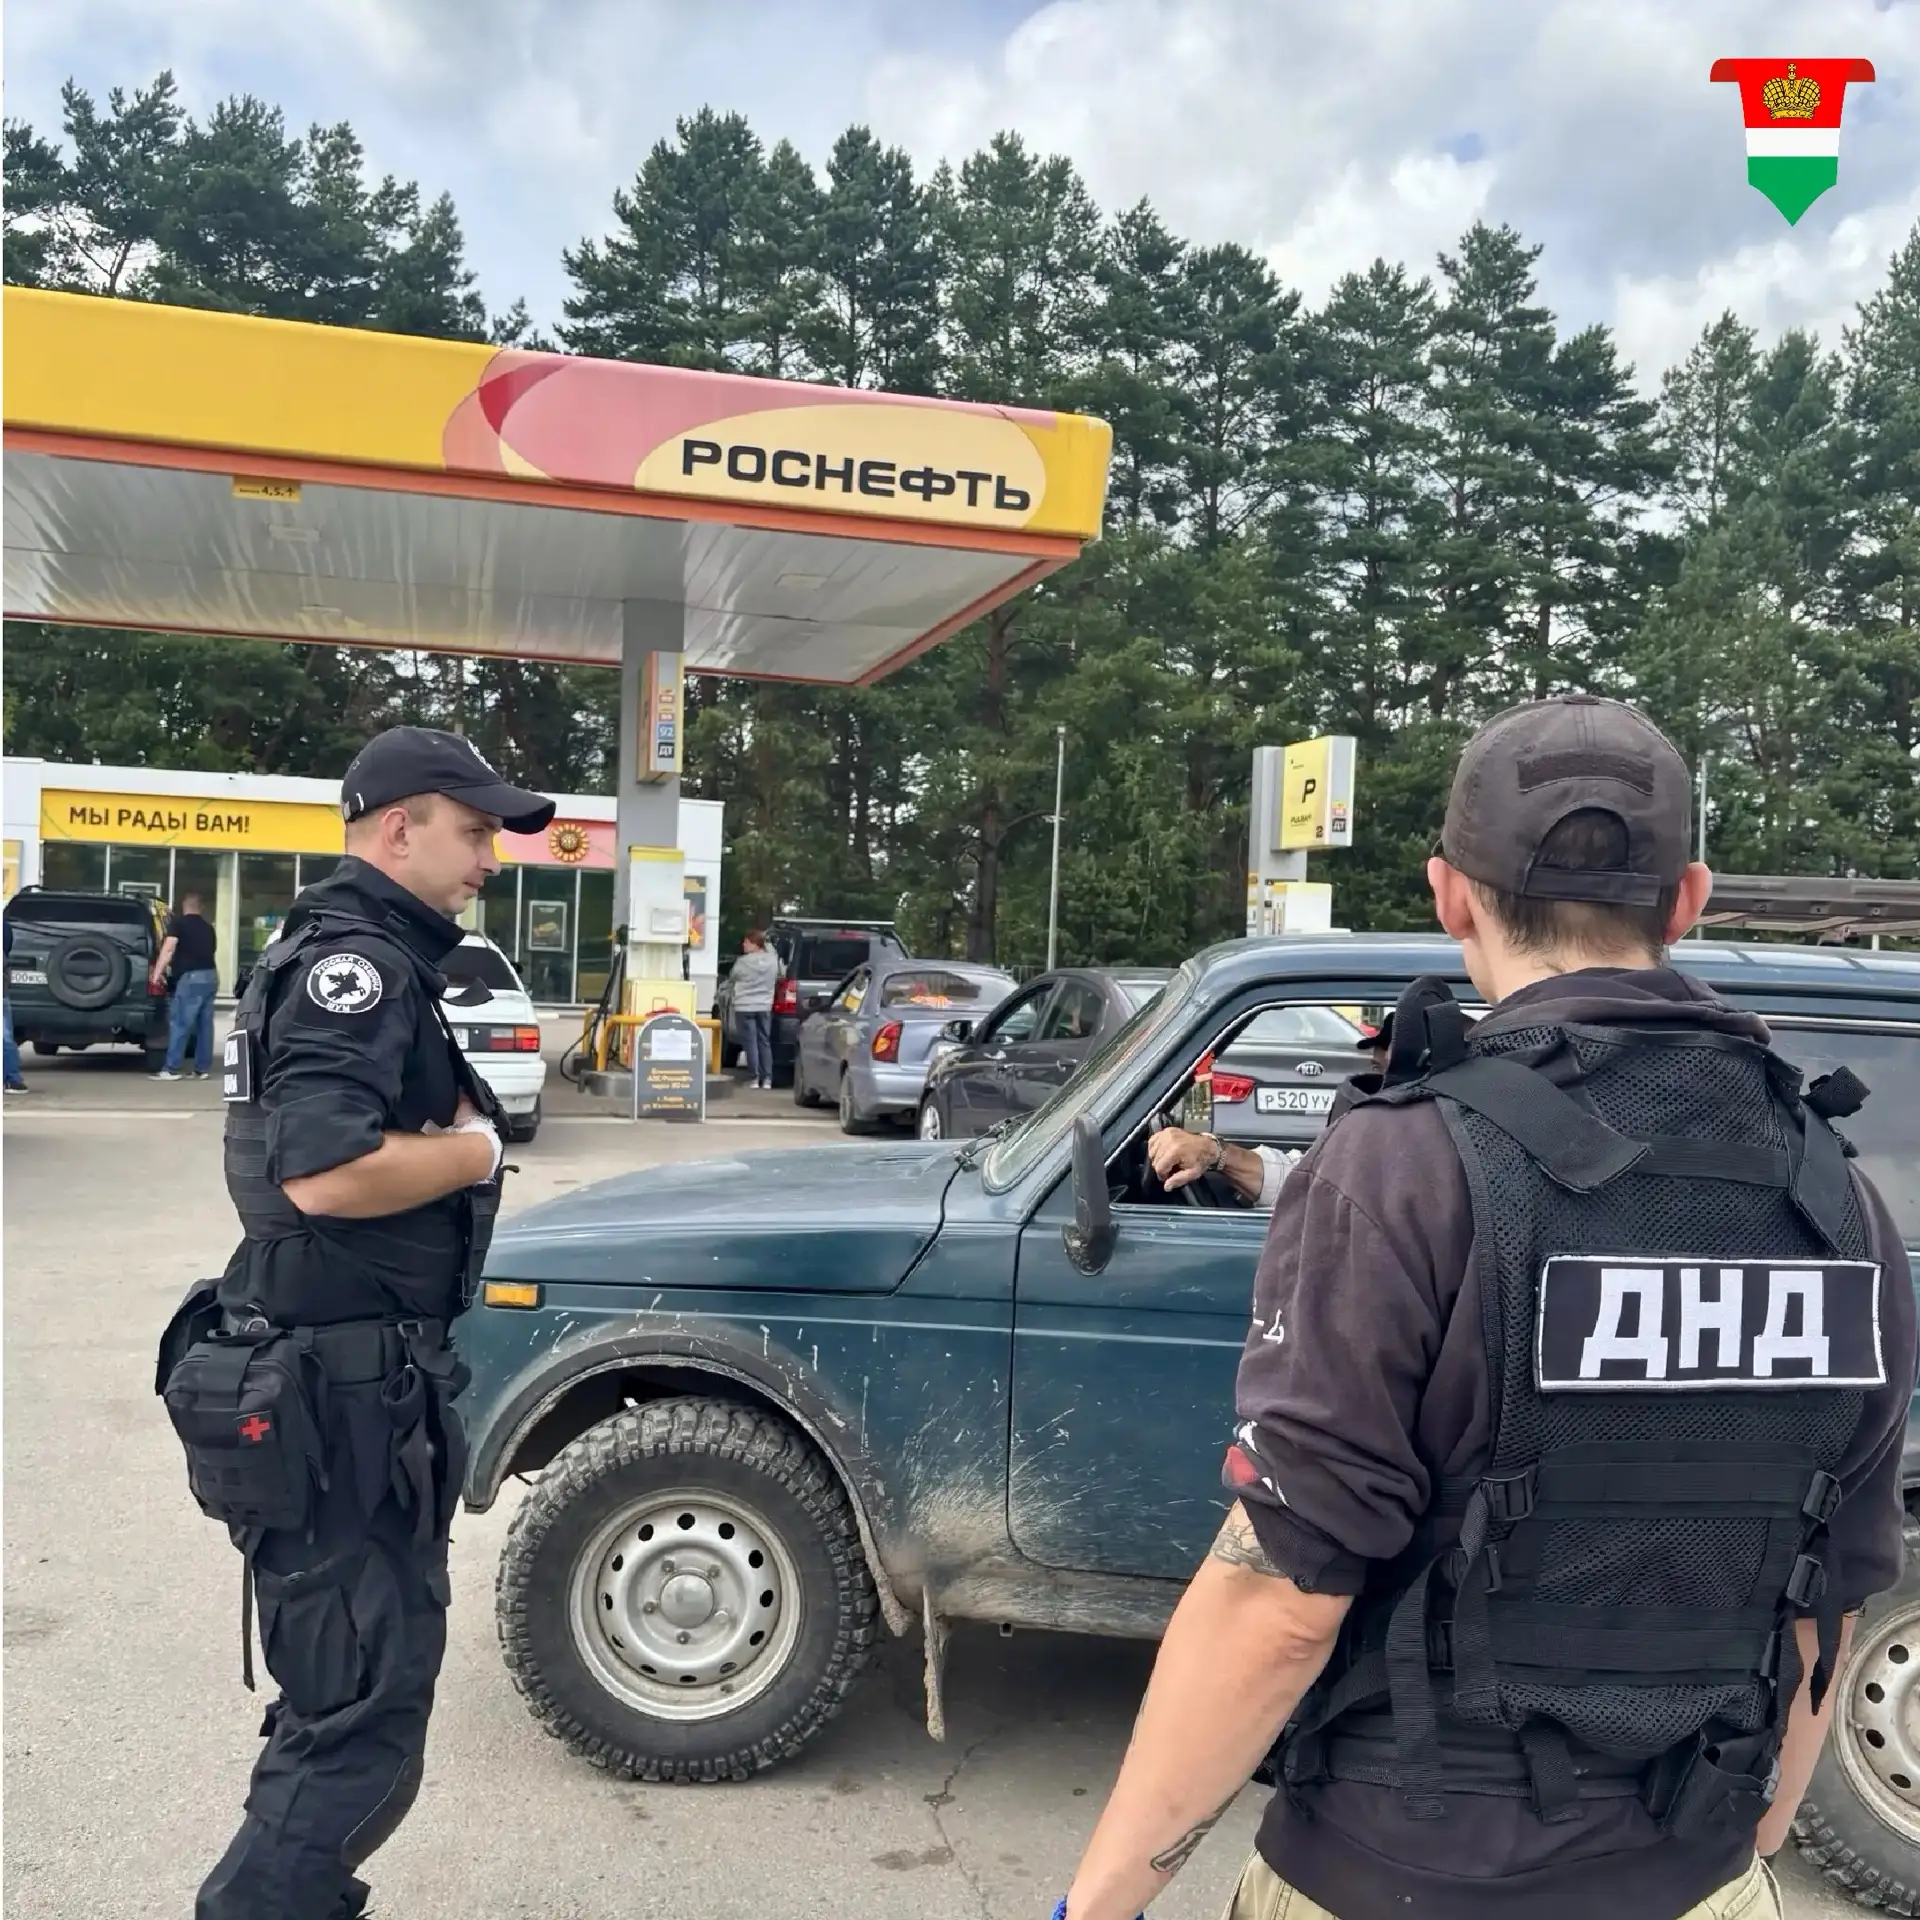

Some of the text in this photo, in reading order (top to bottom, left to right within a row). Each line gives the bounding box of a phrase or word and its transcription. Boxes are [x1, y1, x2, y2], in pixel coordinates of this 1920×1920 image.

[682, 439, 1031, 512] РОСНЕФТЬ
[660, 727, 674, 737] 92
[659, 745, 673, 756] ДТ
[69, 806, 250, 833] МЫ РАДЫ ВАМ!
[1300, 1063, 1321, 1076] KIA
[1579, 1268, 1830, 1378] ДНД
